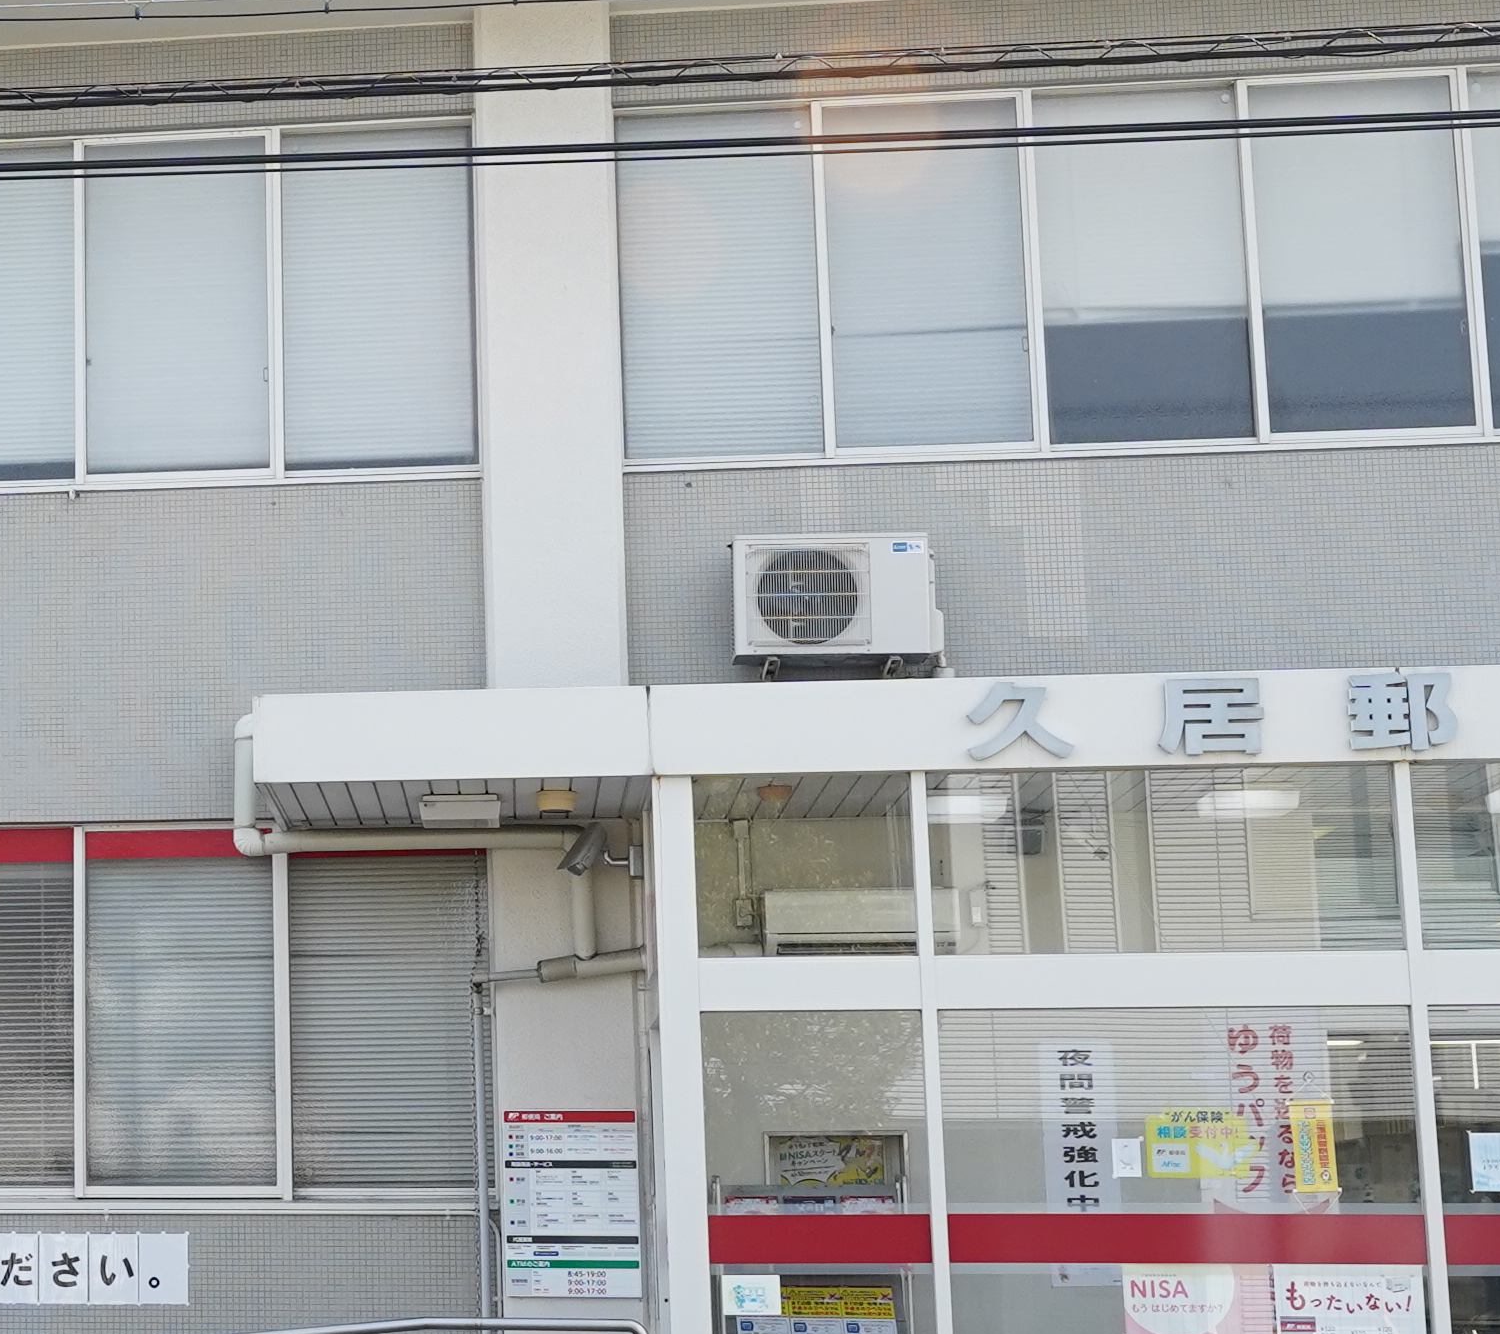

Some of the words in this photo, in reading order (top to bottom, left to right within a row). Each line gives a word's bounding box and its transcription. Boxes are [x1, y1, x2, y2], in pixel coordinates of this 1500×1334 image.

[1130, 1280, 1189, 1299] NISA
[1286, 1281, 1412, 1314] もったいない!
[1131, 1304, 1148, 1313] もう
